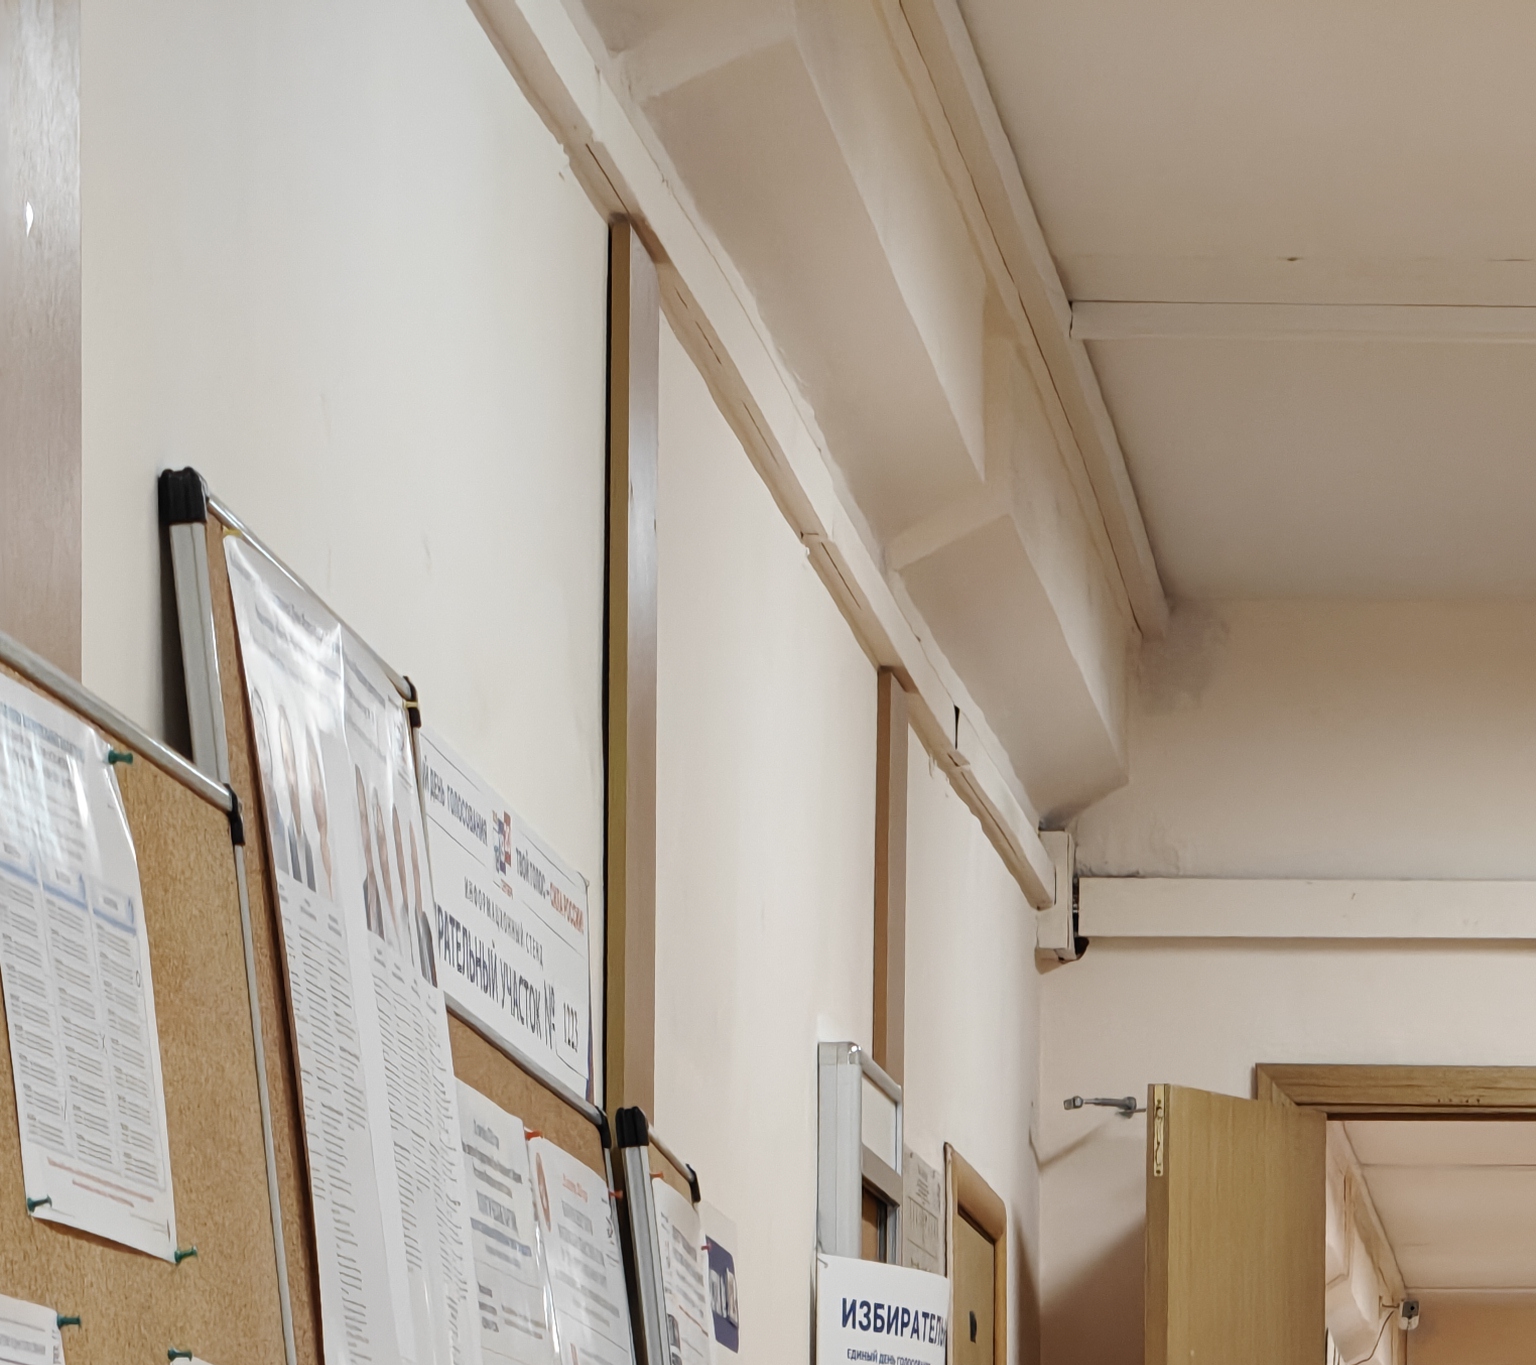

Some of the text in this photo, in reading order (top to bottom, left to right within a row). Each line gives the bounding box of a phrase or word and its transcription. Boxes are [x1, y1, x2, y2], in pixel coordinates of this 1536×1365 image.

[435, 902, 498, 1003] РАТЕЛЬНЫЙ
[500, 956, 542, 1040] УЧАСТОК
[847, 1348, 878, 1364] ЕДИНЫЙ
[879, 1353, 896, 1365] ДЕНЬ
